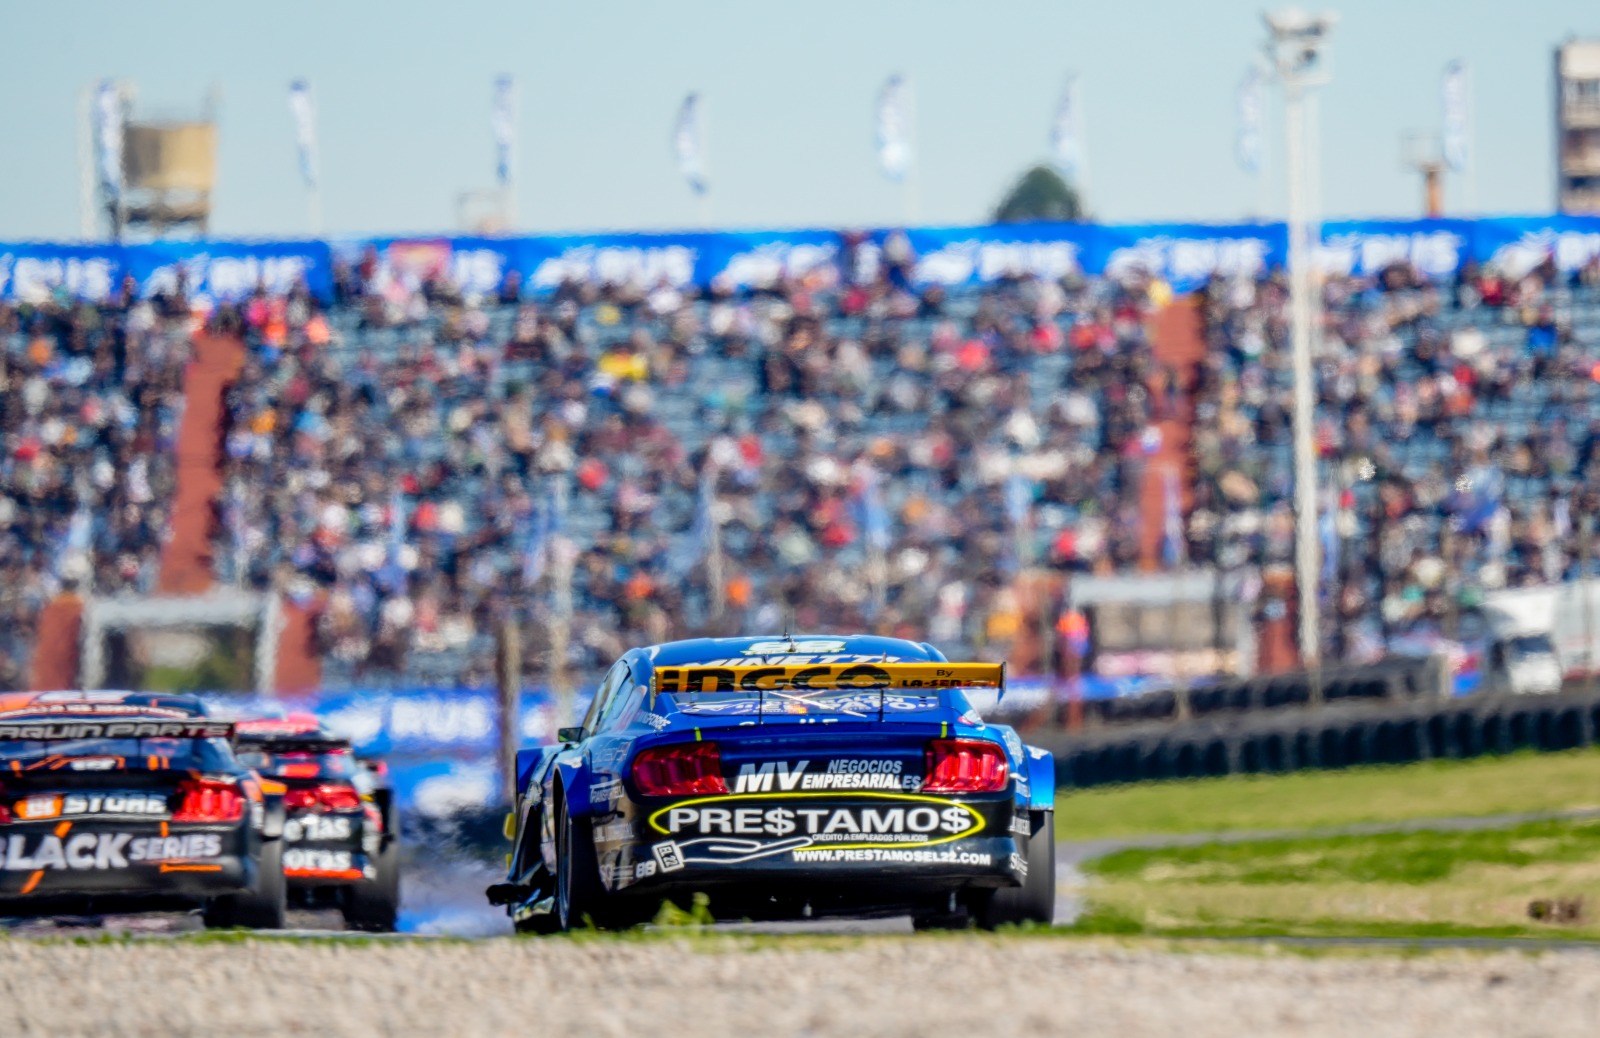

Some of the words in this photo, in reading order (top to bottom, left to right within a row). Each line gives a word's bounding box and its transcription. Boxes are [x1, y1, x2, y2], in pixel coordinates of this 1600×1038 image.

[936, 670, 954, 678] By
[827, 759, 903, 774] NEGOCIOS
[735, 760, 810, 793] MV
[801, 773, 922, 790] EMPRESARIALES
[129, 834, 223, 859] SERIES
[792, 847, 991, 867] WWW.PRESTAMOSEL22.COM
